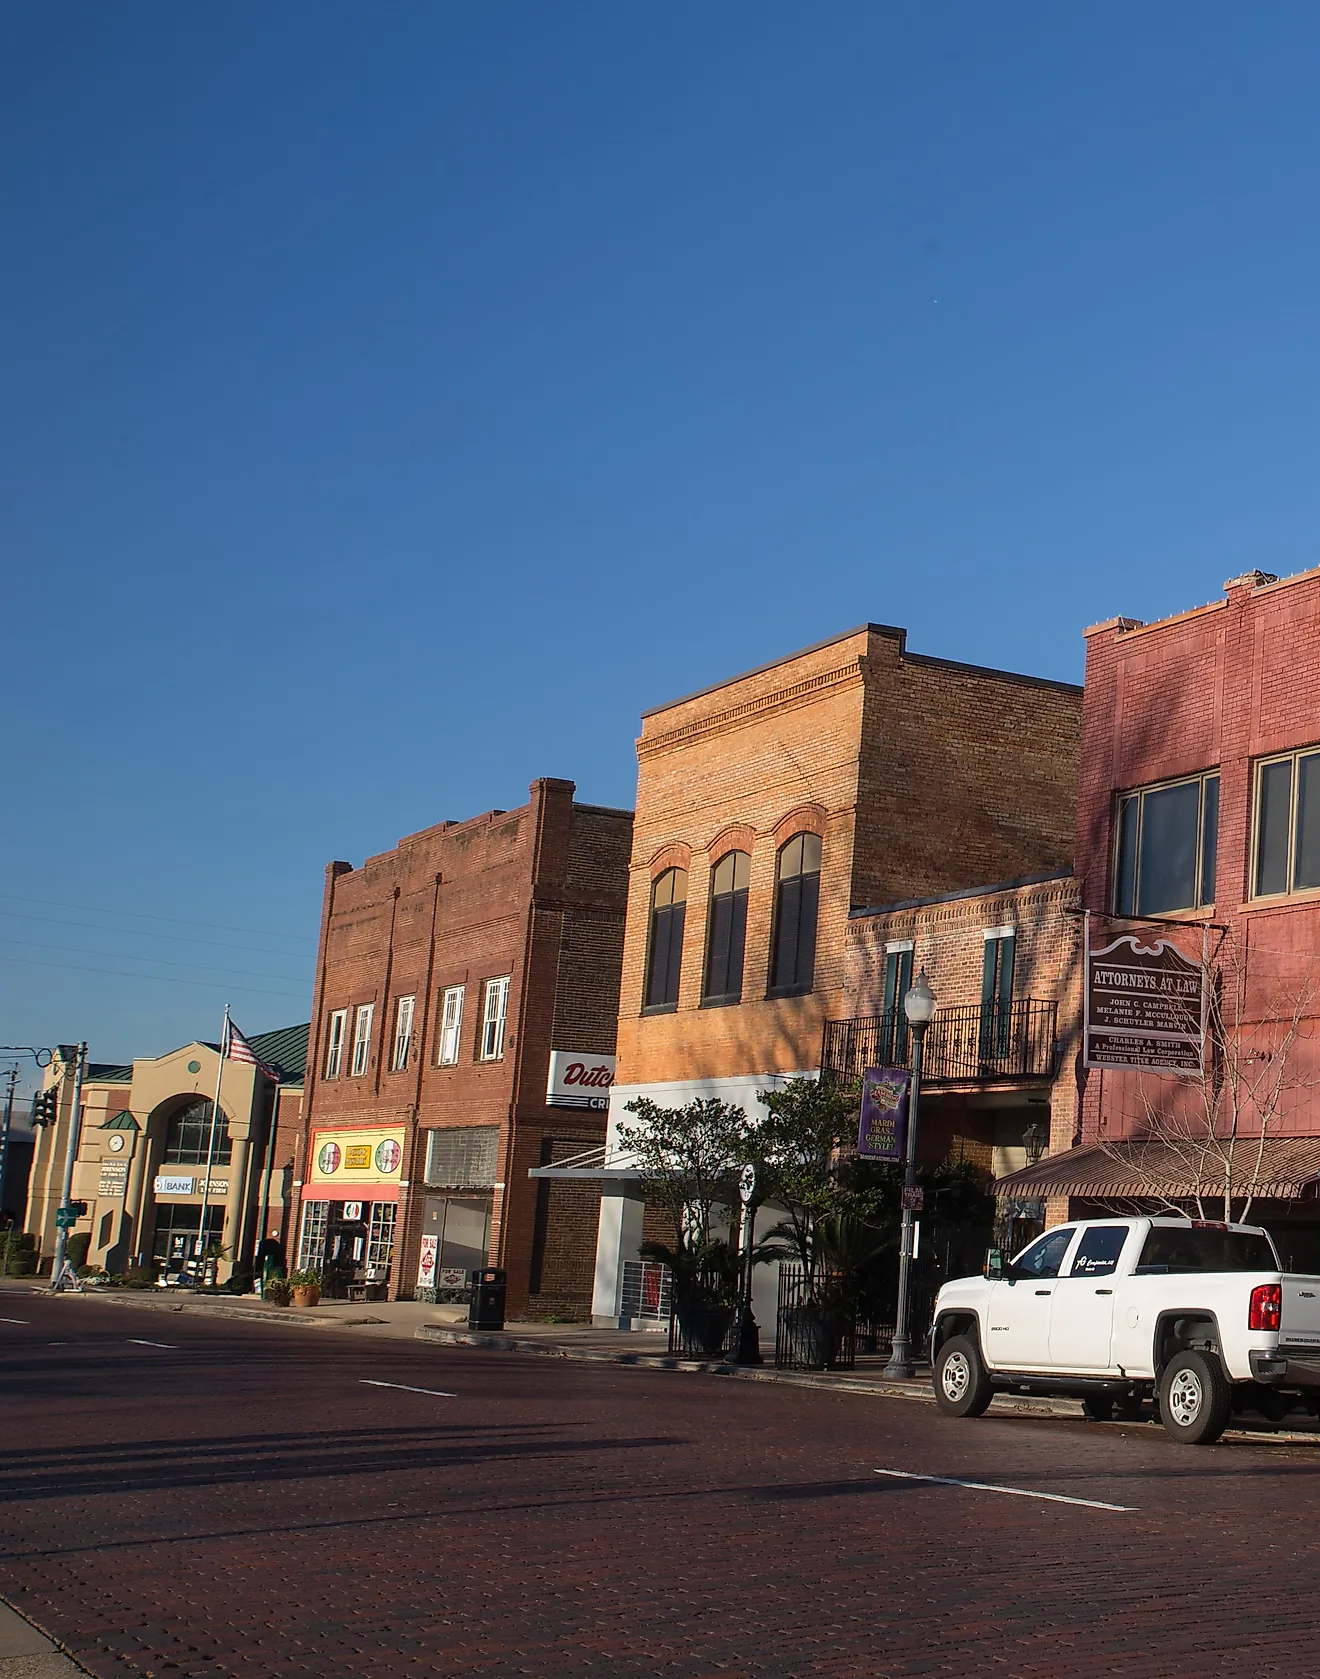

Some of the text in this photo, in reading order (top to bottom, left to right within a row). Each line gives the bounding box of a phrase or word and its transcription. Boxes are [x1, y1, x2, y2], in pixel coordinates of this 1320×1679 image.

[1093, 970, 1198, 994] ATTORNEYS AT LAW
[1109, 998, 1131, 1007] JOHN
[1096, 1007, 1133, 1016] MELANIE
[1113, 1017, 1154, 1027] SCHUYLER
[1157, 1021, 1186, 1030] MARVIN
[1109, 1037, 1144, 1046] CHARLES
[1156, 1041, 1181, 1049] SMITH
[1102, 1044, 1140, 1054] Professional
[1157, 1048, 1194, 1057] Corporation
[1096, 1054, 1128, 1062] WEBSTER
[1130, 1056, 1150, 1065] TITLE
[871, 1119, 895, 1128] MARDI
[865, 1134, 896, 1143] GERMAN
[868, 1142, 893, 1151] STYLE!
[166, 1182, 191, 1191] BANK
[199, 1179, 229, 1188] JONSON
